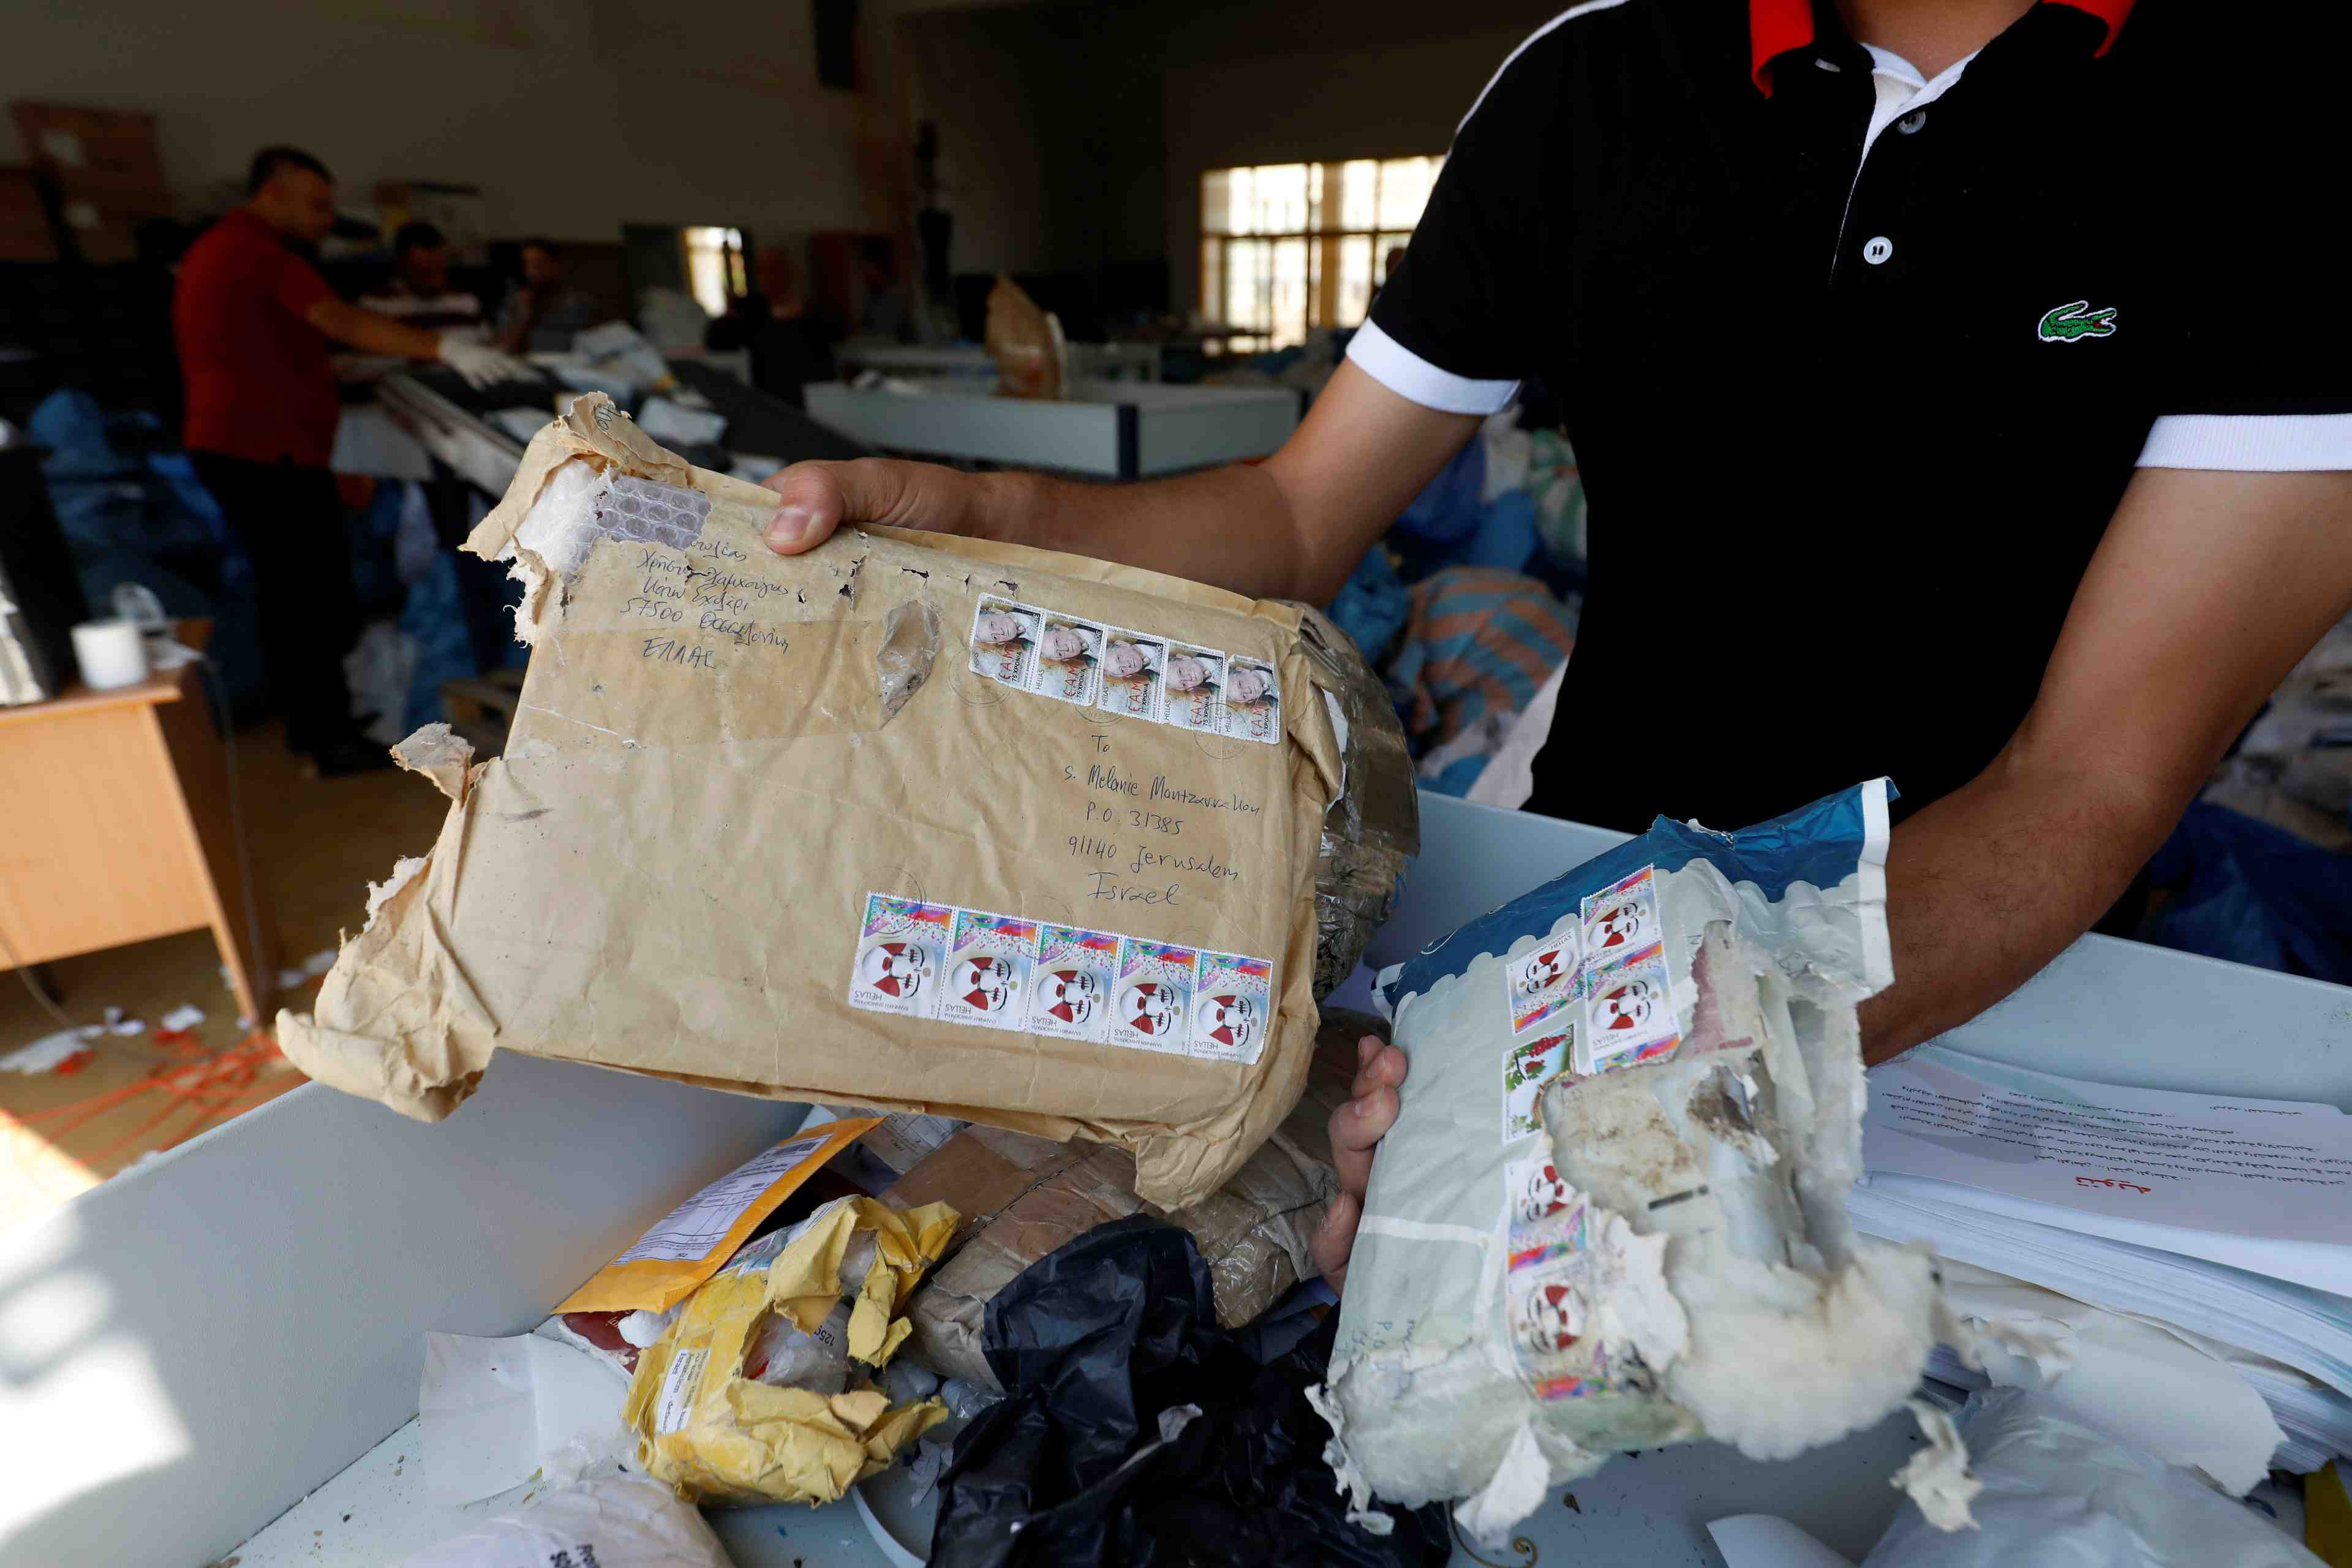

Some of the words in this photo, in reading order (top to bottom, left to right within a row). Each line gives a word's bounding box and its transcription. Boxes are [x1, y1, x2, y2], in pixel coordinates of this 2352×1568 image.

[619, 597, 684, 622] 57500
[1034, 669, 1044, 690] HELLAS
[1091, 735, 1110, 753] To
[1088, 764, 1139, 796] Melanie
[1129, 810, 1185, 835] 31385
[1068, 835, 1117, 858] 91140
[1130, 845, 1238, 881] Jerusalem
[1087, 872, 1180, 905] Israel
[854, 990, 882, 1001] HELLAS
[946, 1004, 971, 1014] HELLAS
[1032, 1016, 1057, 1026] HELLAS
[1114, 1029, 1139, 1039] HELLAS
[1194, 1041, 1218, 1050] HELLAS
[2077, 1177, 2150, 1193] تنويه
